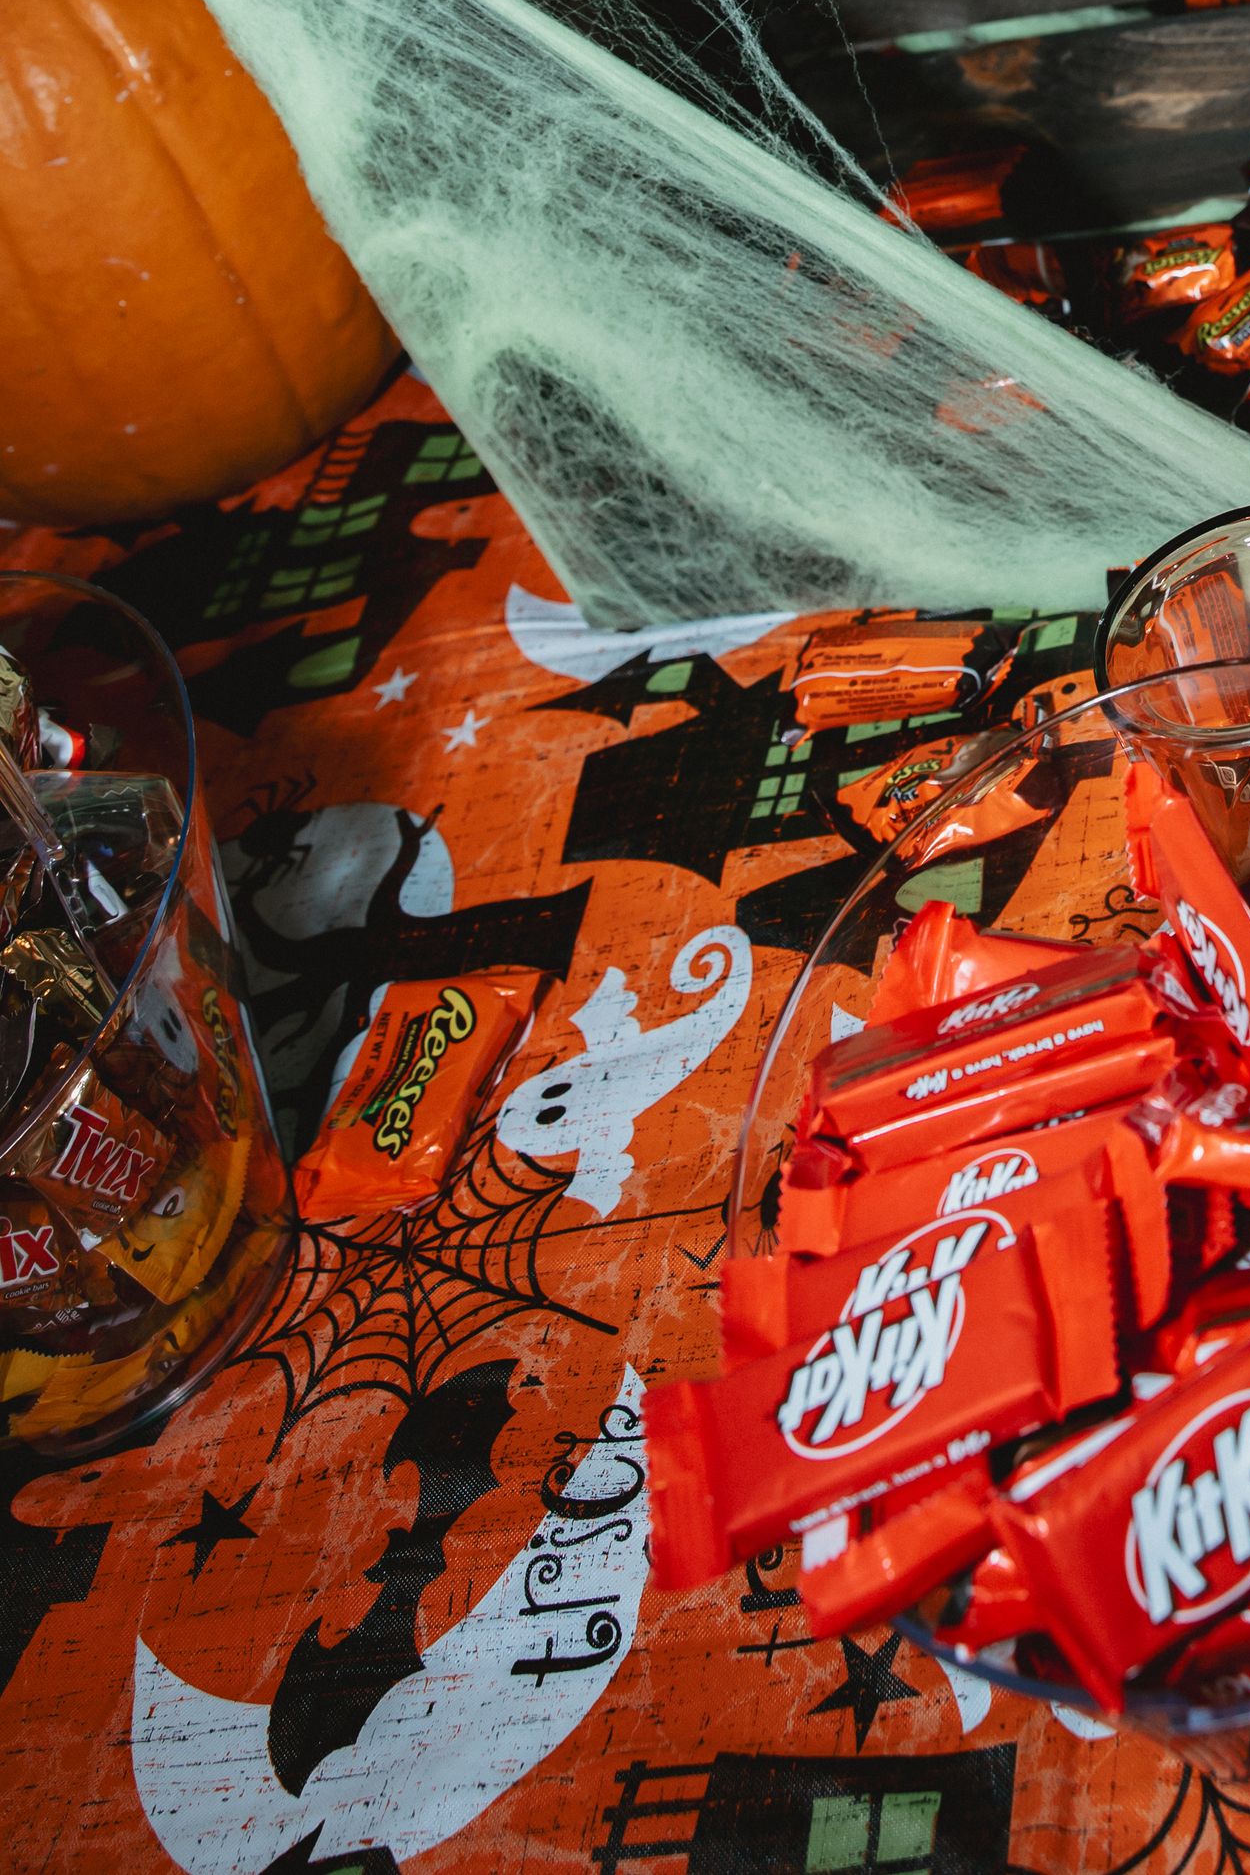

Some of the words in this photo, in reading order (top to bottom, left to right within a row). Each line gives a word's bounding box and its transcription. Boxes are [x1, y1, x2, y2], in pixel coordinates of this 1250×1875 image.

[942, 983, 1040, 1031] KitKat
[375, 1011, 392, 1039] NET
[1068, 1021, 1104, 1041] have
[369, 1040, 384, 1062] WT
[401, 1023, 418, 1062] PEANUT
[1055, 1034, 1066, 1046] a
[373, 986, 477, 1162] Reese's
[951, 1069, 962, 1081] a
[965, 1055, 1002, 1076] have
[5, 1285, 31, 1300] cookie
[32, 1280, 50, 1294] bars
[778, 1272, 962, 1445] KitKat
